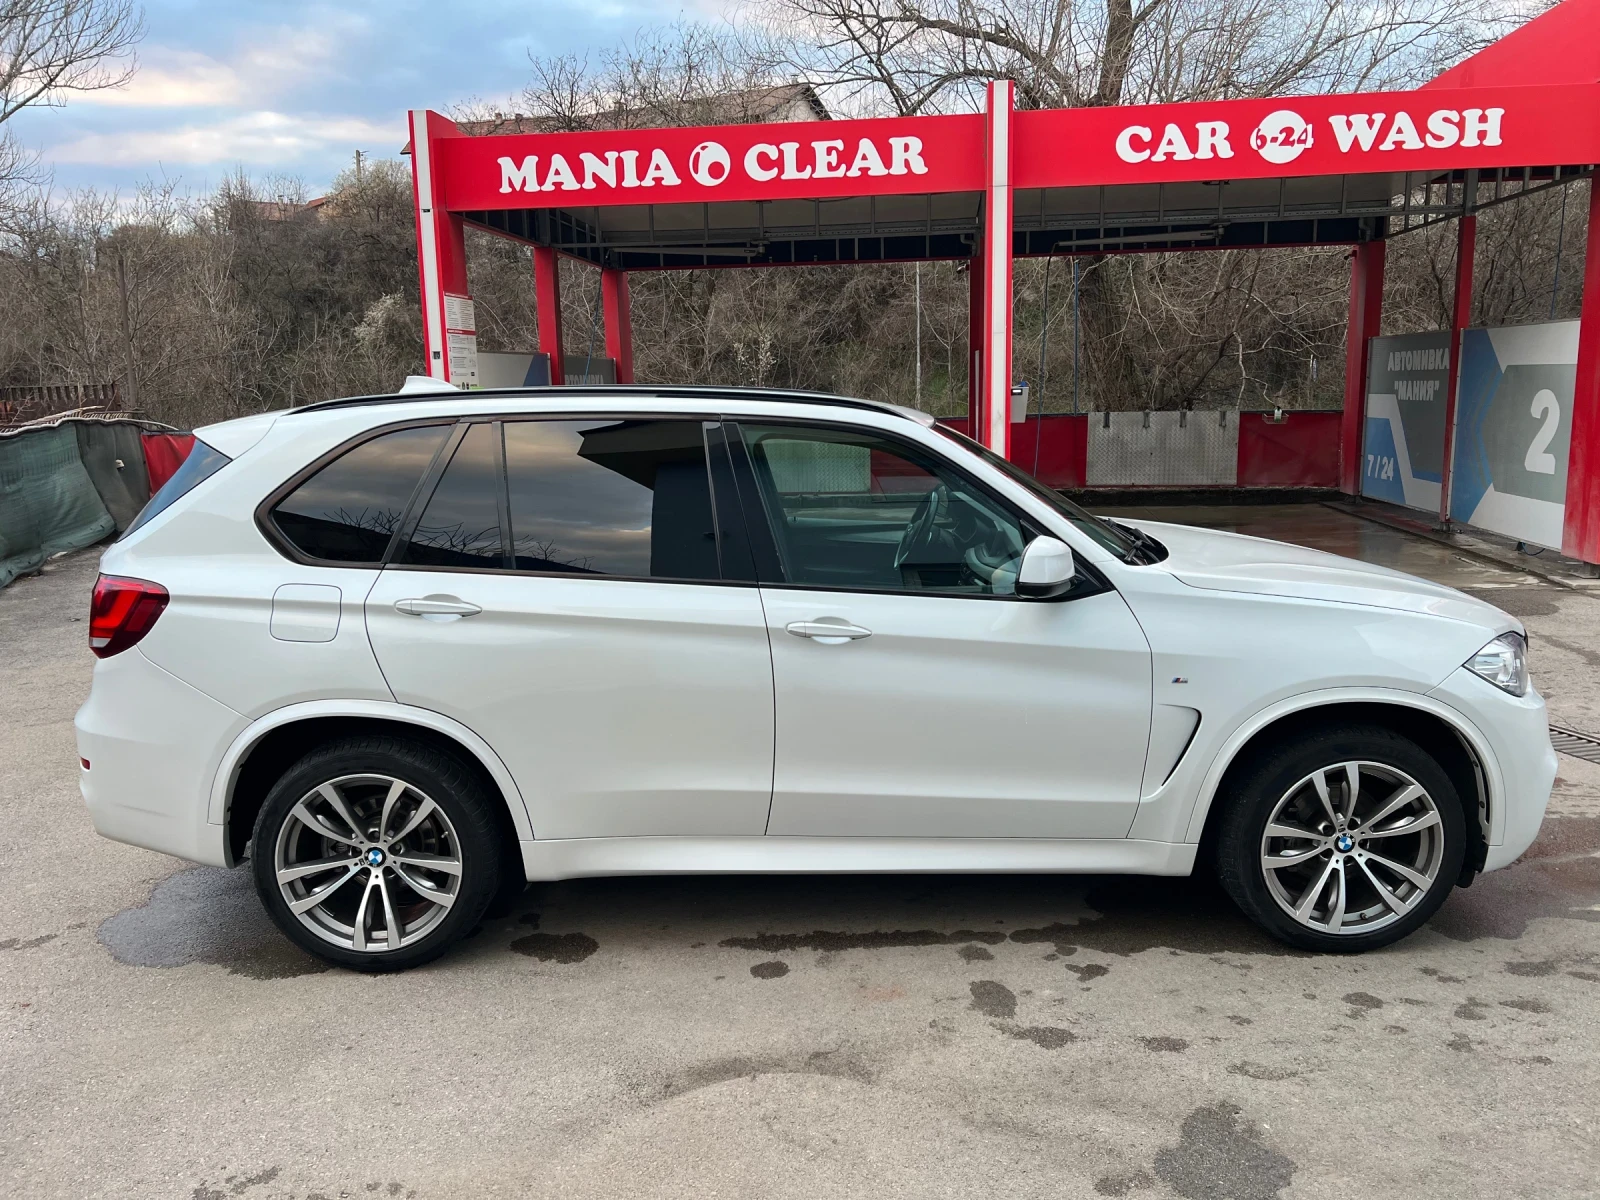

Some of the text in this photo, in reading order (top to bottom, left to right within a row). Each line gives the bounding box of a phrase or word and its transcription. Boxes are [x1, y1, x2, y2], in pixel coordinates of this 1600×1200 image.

[1115, 107, 1505, 163] CAR 6-24 WASH
[497, 136, 929, 194] MANIA CLEAR
[1387, 347, 1450, 372] АВТОМИВКА
[1524, 388, 1561, 475] 2
